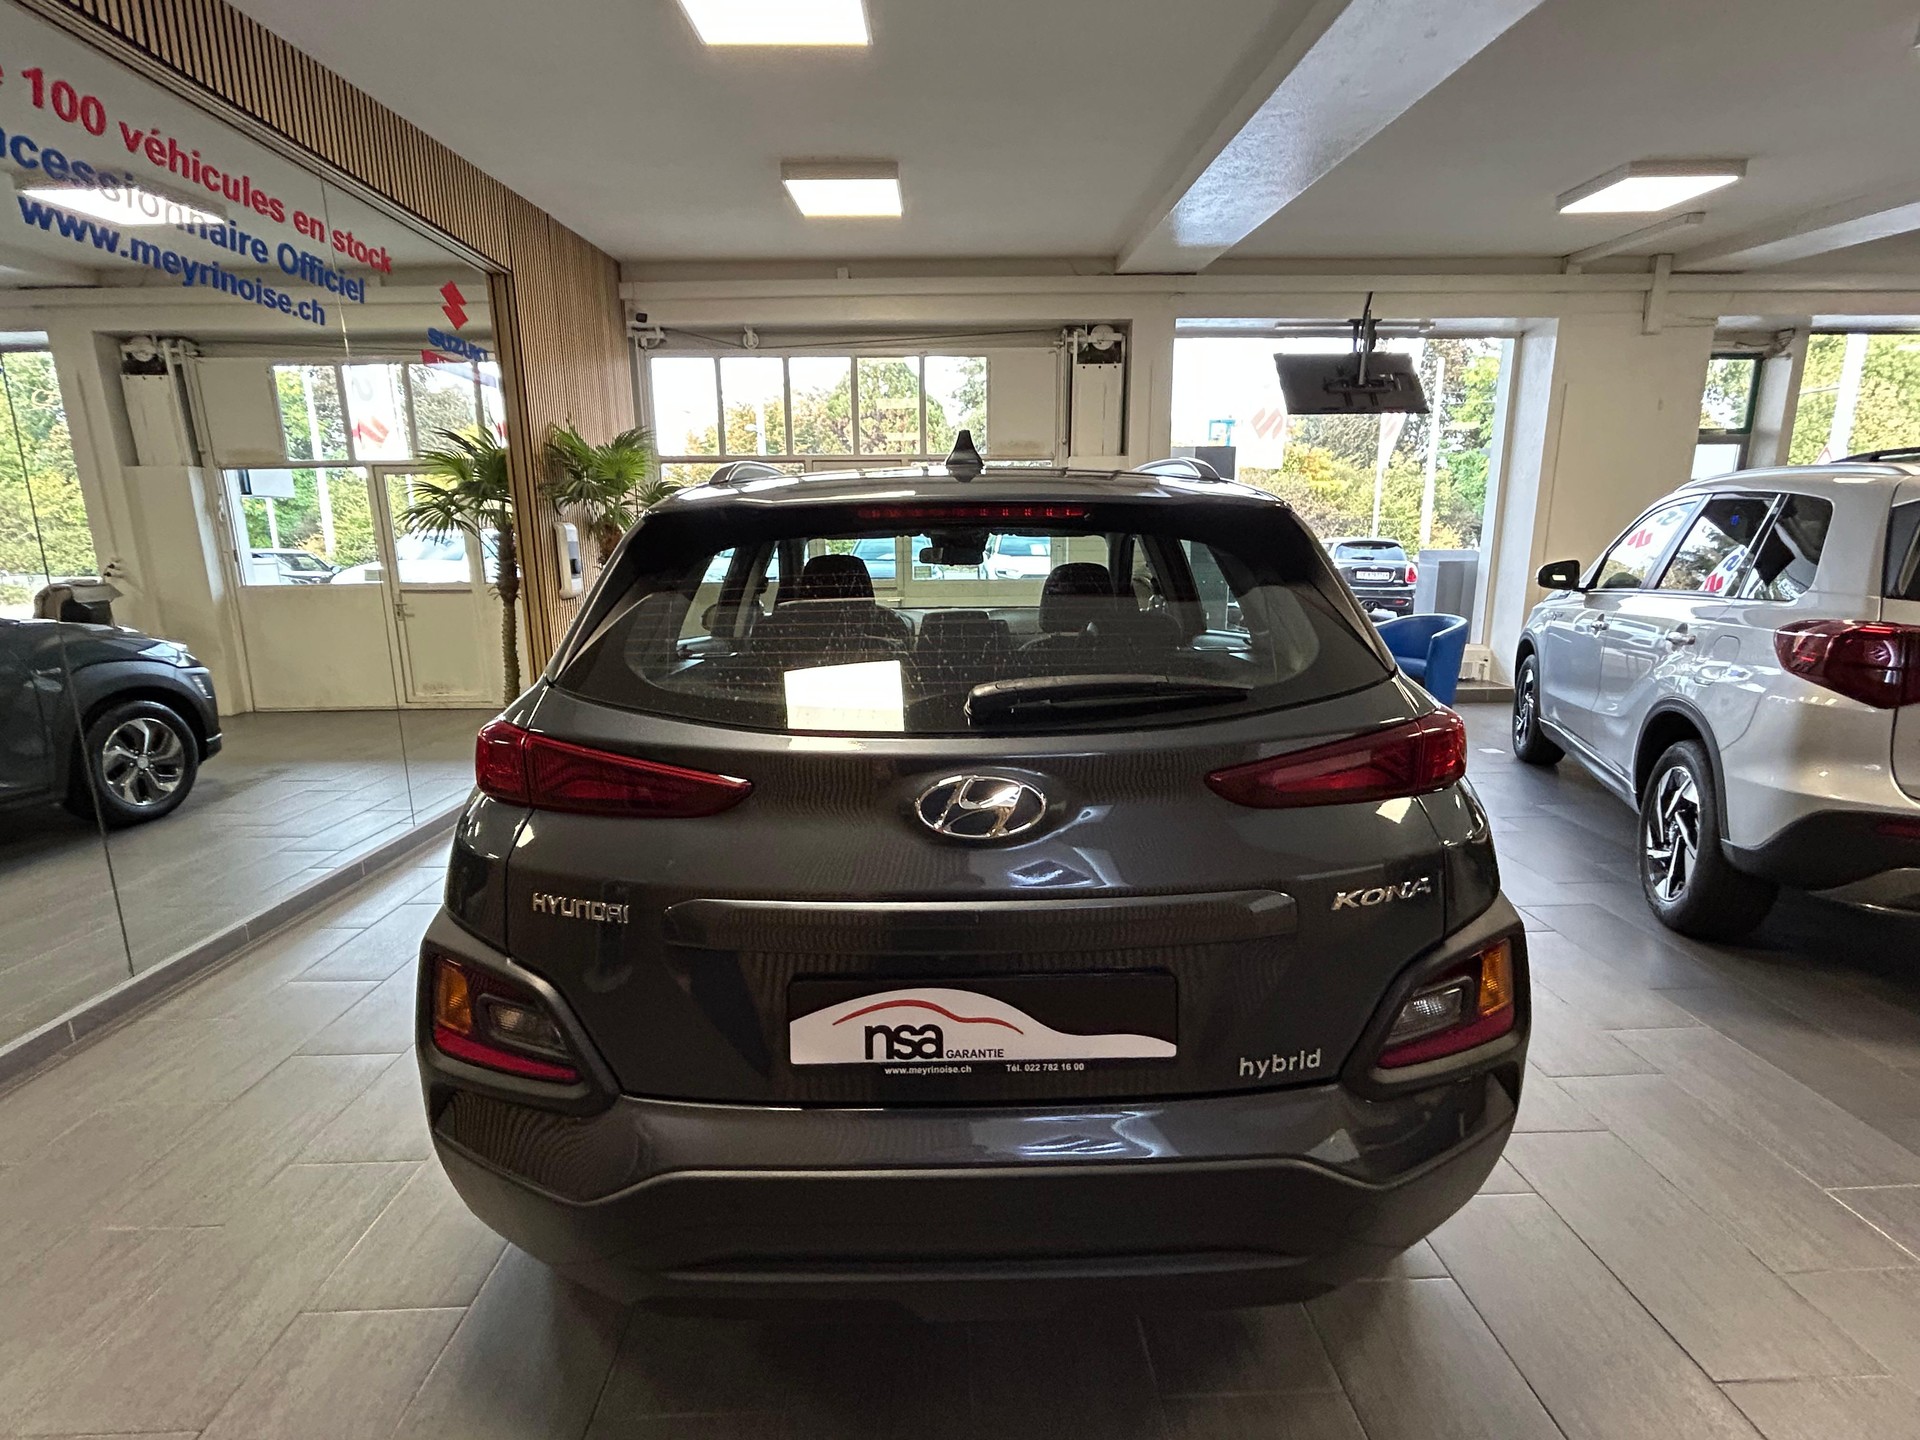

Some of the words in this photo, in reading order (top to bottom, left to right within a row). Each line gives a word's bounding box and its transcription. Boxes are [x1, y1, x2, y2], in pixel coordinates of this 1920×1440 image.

[21, 67, 108, 137] 100
[118, 121, 287, 225] véhicules
[293, 210, 327, 243] en
[332, 229, 393, 275] stock
[0, 127, 269, 265] cessionnaire
[277, 242, 365, 304] Officiel
[17, 195, 326, 326] www.meyrinoise.ch
[532, 892, 629, 924] HYUNDAI
[1331, 877, 1431, 911] KONA
[864, 1023, 945, 1060] nsa
[945, 1048, 1005, 1059] GARANTIE
[884, 1064, 972, 1076] www.meyrinoise.ch
[1006, 1063, 1022, 1072] Tél.
[1024, 1063, 1041, 1072] 022
[1042, 1063, 1059, 1072] 782
[1061, 1062, 1071, 1071] 16
[1073, 1062, 1085, 1071] 00
[1239, 1047, 1322, 1079] hybrid
